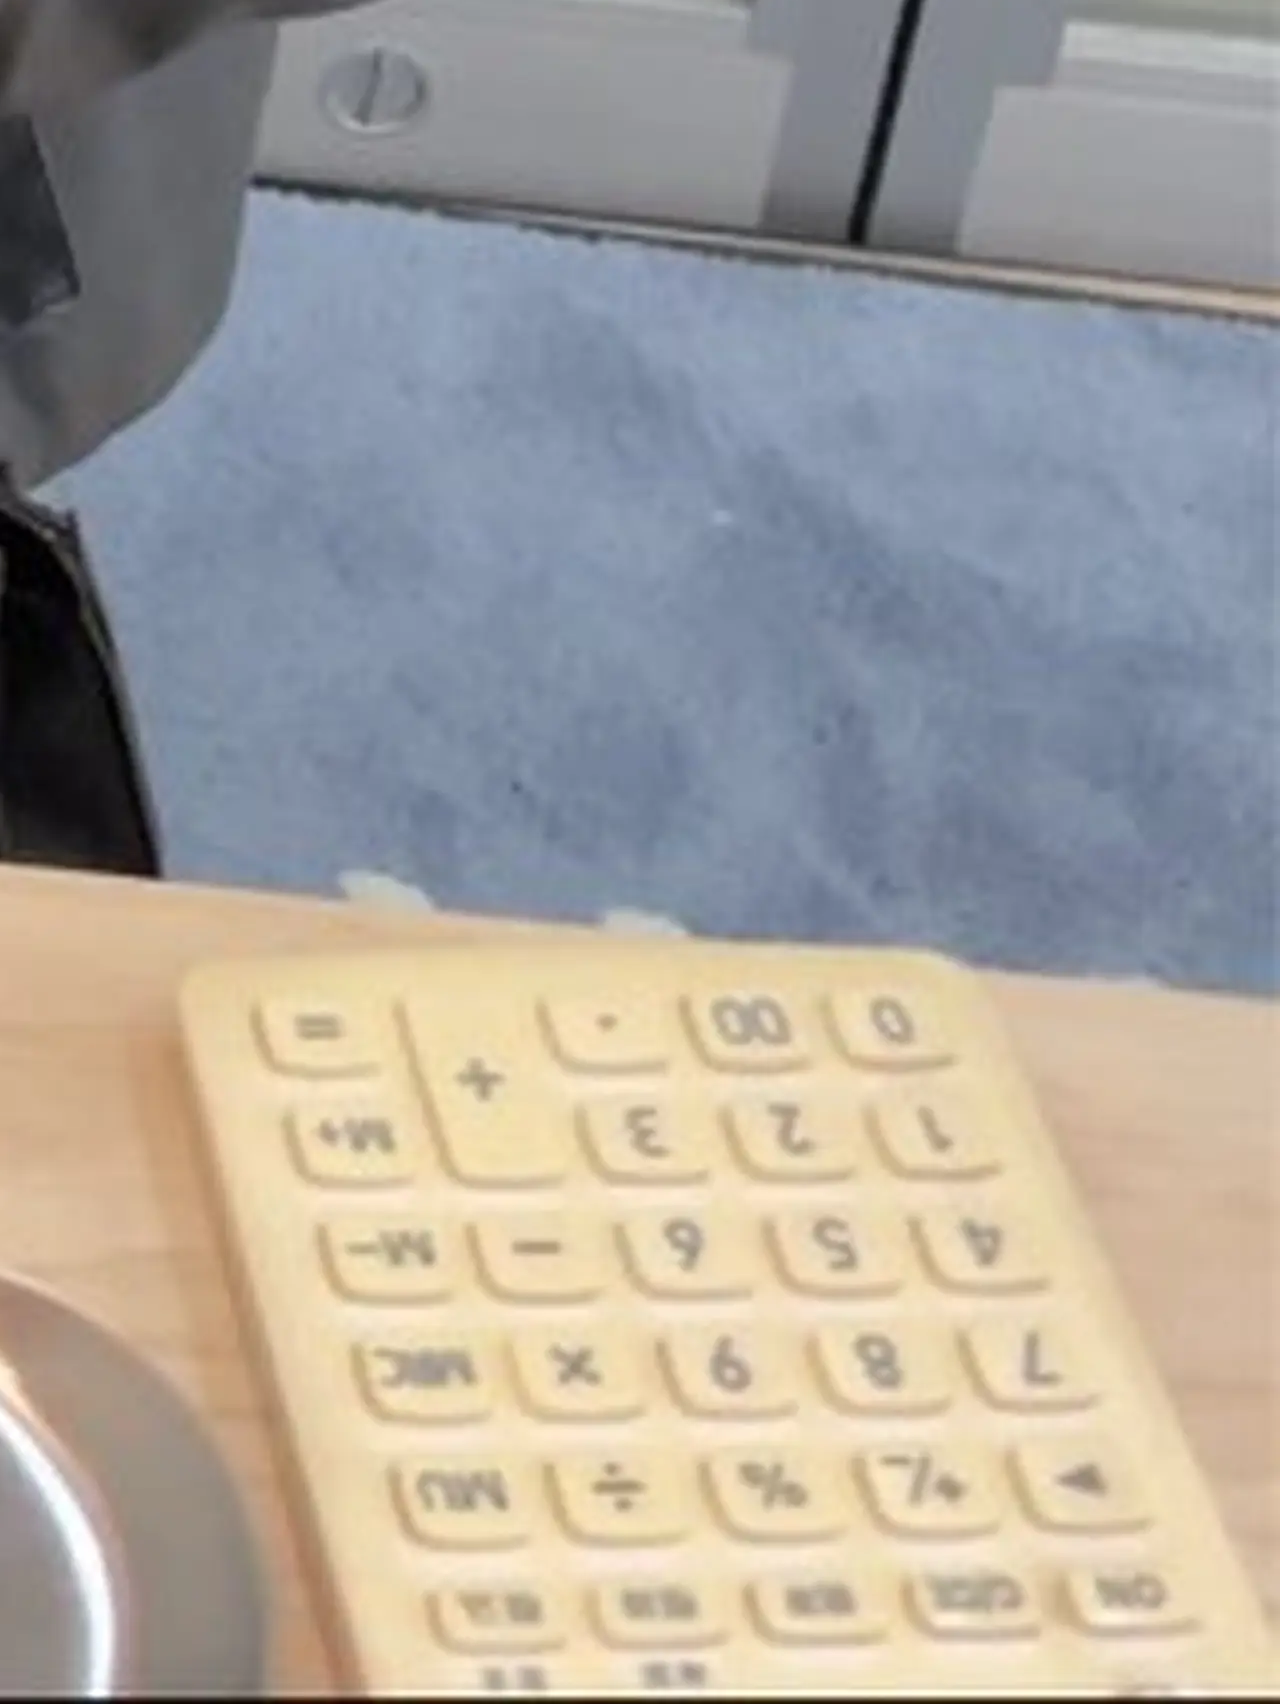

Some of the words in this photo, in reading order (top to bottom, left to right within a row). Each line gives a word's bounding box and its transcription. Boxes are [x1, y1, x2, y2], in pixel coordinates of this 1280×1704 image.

[710, 994, 791, 1046] 00
[869, 995, 915, 1044] 0
[624, 1104, 671, 1158] 3
[766, 1102, 815, 1156] 2
[917, 1105, 954, 1153] 1
[663, 1216, 705, 1272] 6
[811, 1215, 859, 1271] 5
[962, 1216, 1004, 1267] 4
[708, 1334, 752, 1393] 9
[854, 1333, 903, 1389] 8
[1022, 1329, 1064, 1386] 7
